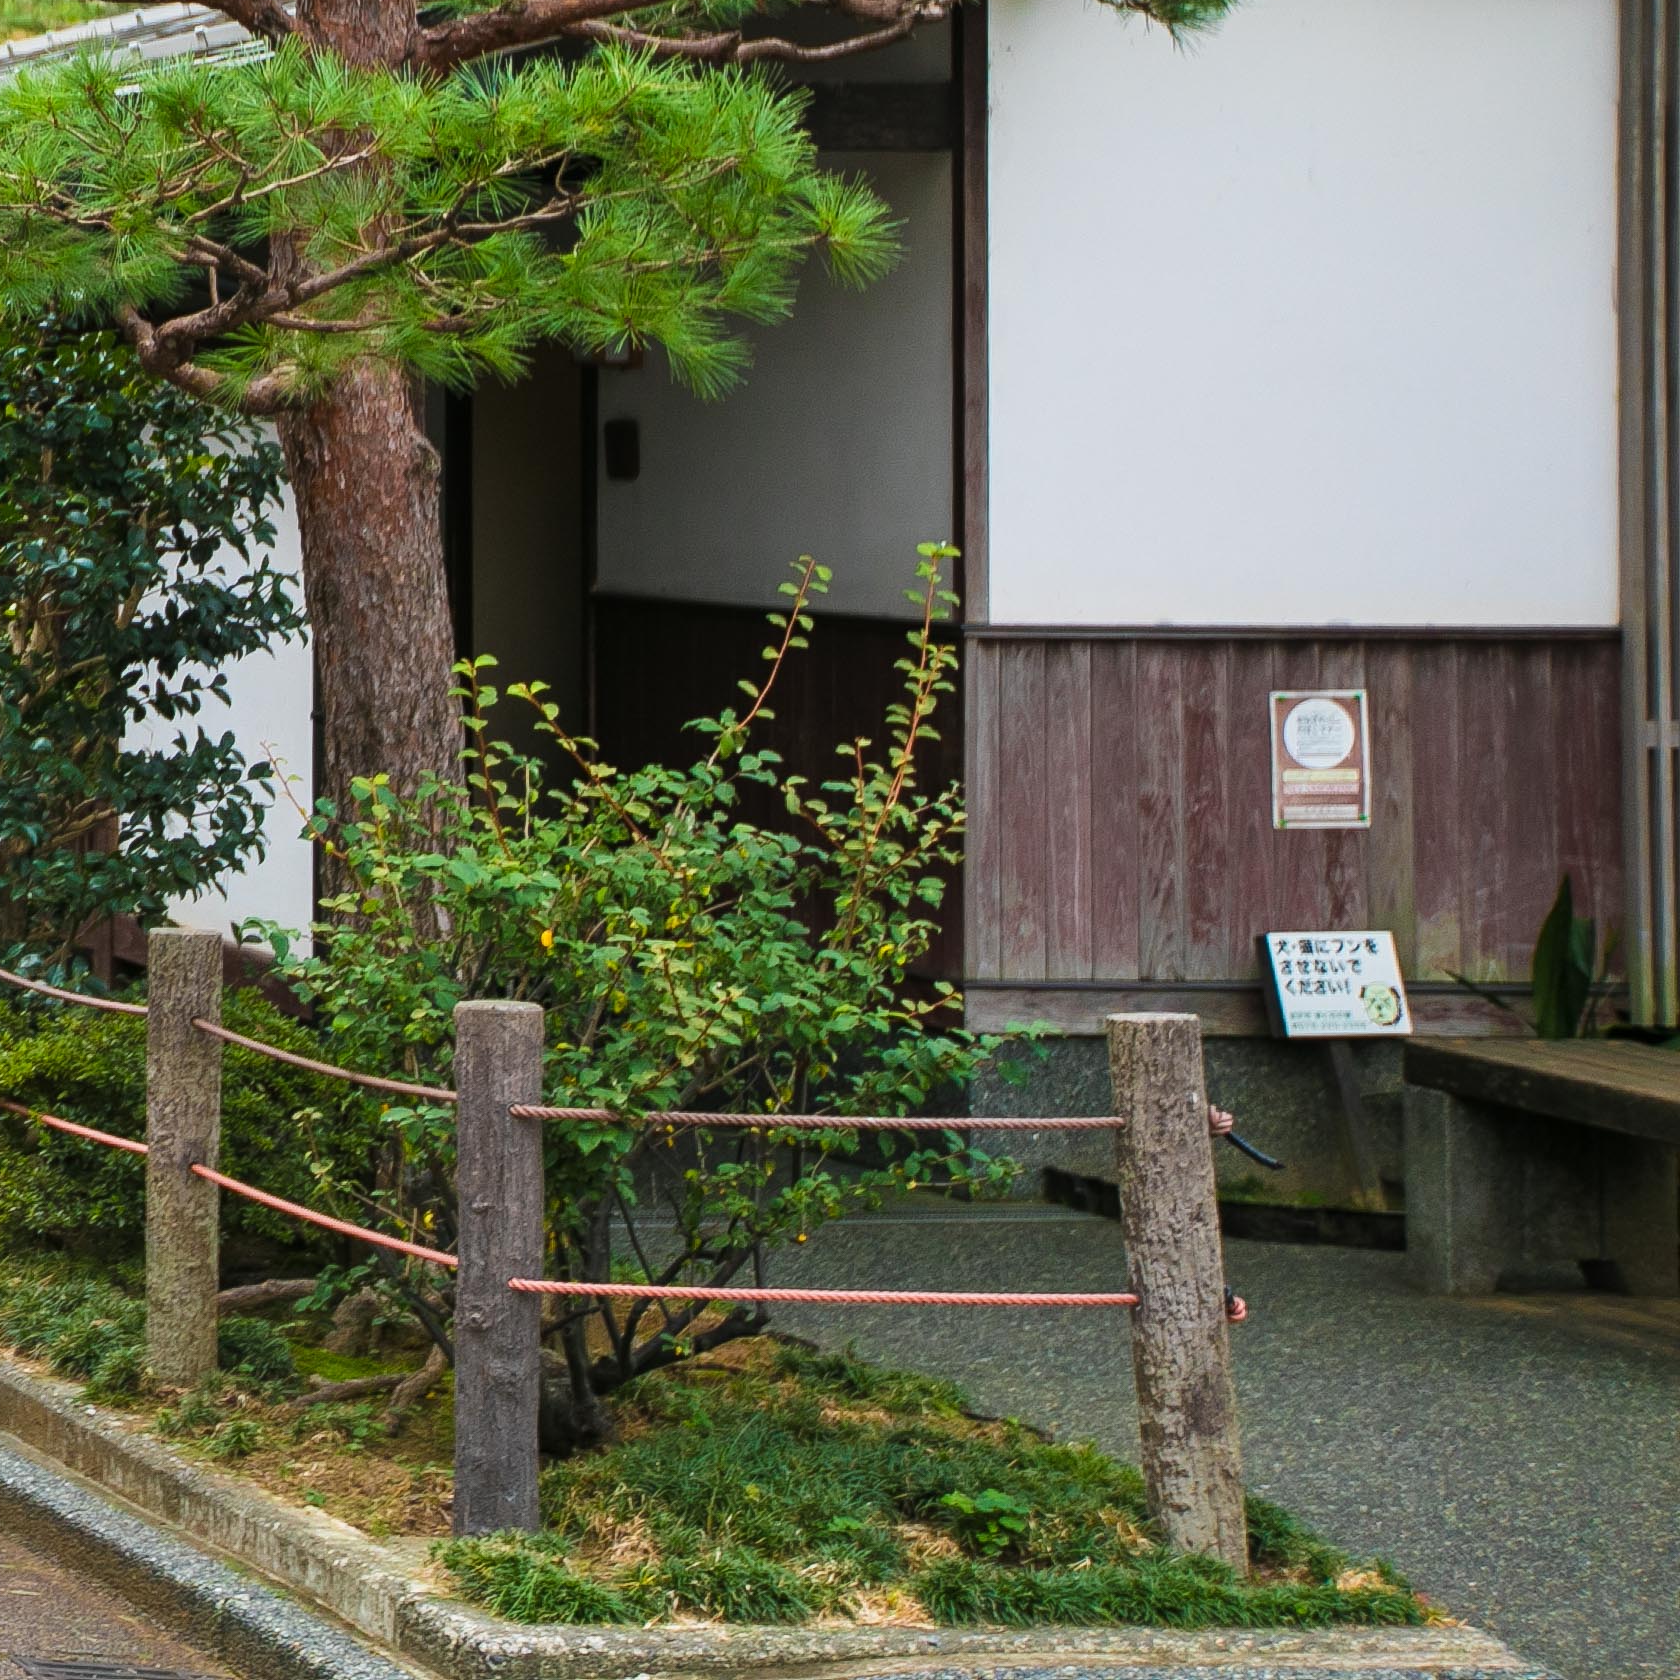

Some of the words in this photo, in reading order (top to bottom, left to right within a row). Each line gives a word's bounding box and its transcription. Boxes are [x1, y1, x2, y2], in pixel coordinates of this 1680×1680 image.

[1279, 959, 1363, 976] させないで
